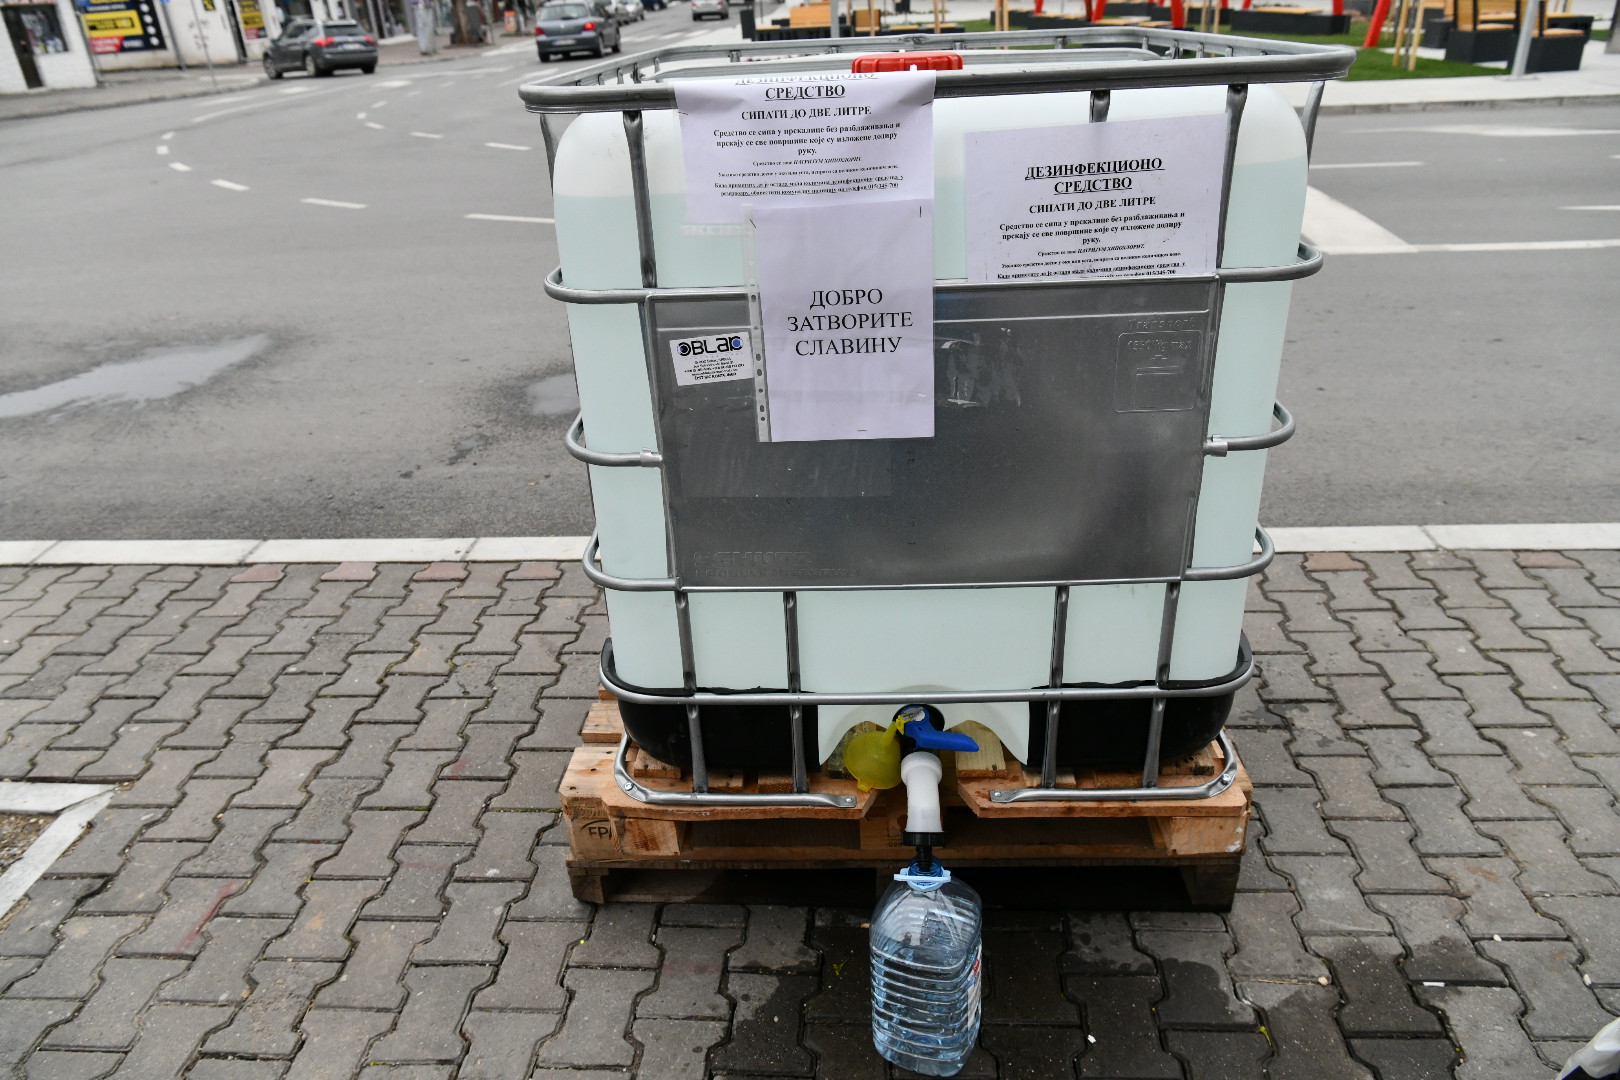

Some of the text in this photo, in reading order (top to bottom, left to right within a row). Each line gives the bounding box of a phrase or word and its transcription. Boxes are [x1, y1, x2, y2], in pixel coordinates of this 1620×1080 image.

[765, 84, 846, 101] СРЕДСТВО
[741, 106, 872, 120] СИПАТИ ДО ДВЕ ЛИТРЕ
[826, 125, 838, 133] без
[1024, 157, 1166, 181] ДЕЗИНФЕКЦИОНО
[1054, 176, 1133, 195] СРЕДСТВО
[1029, 196, 1156, 214] СИПАТИ ДО ДВЕ ЛИТРЕ
[809, 287, 884, 310] ДОБРО
[787, 311, 914, 332] ЗАТВОРИТЕ
[795, 336, 903, 356] СЛАВИНУ
